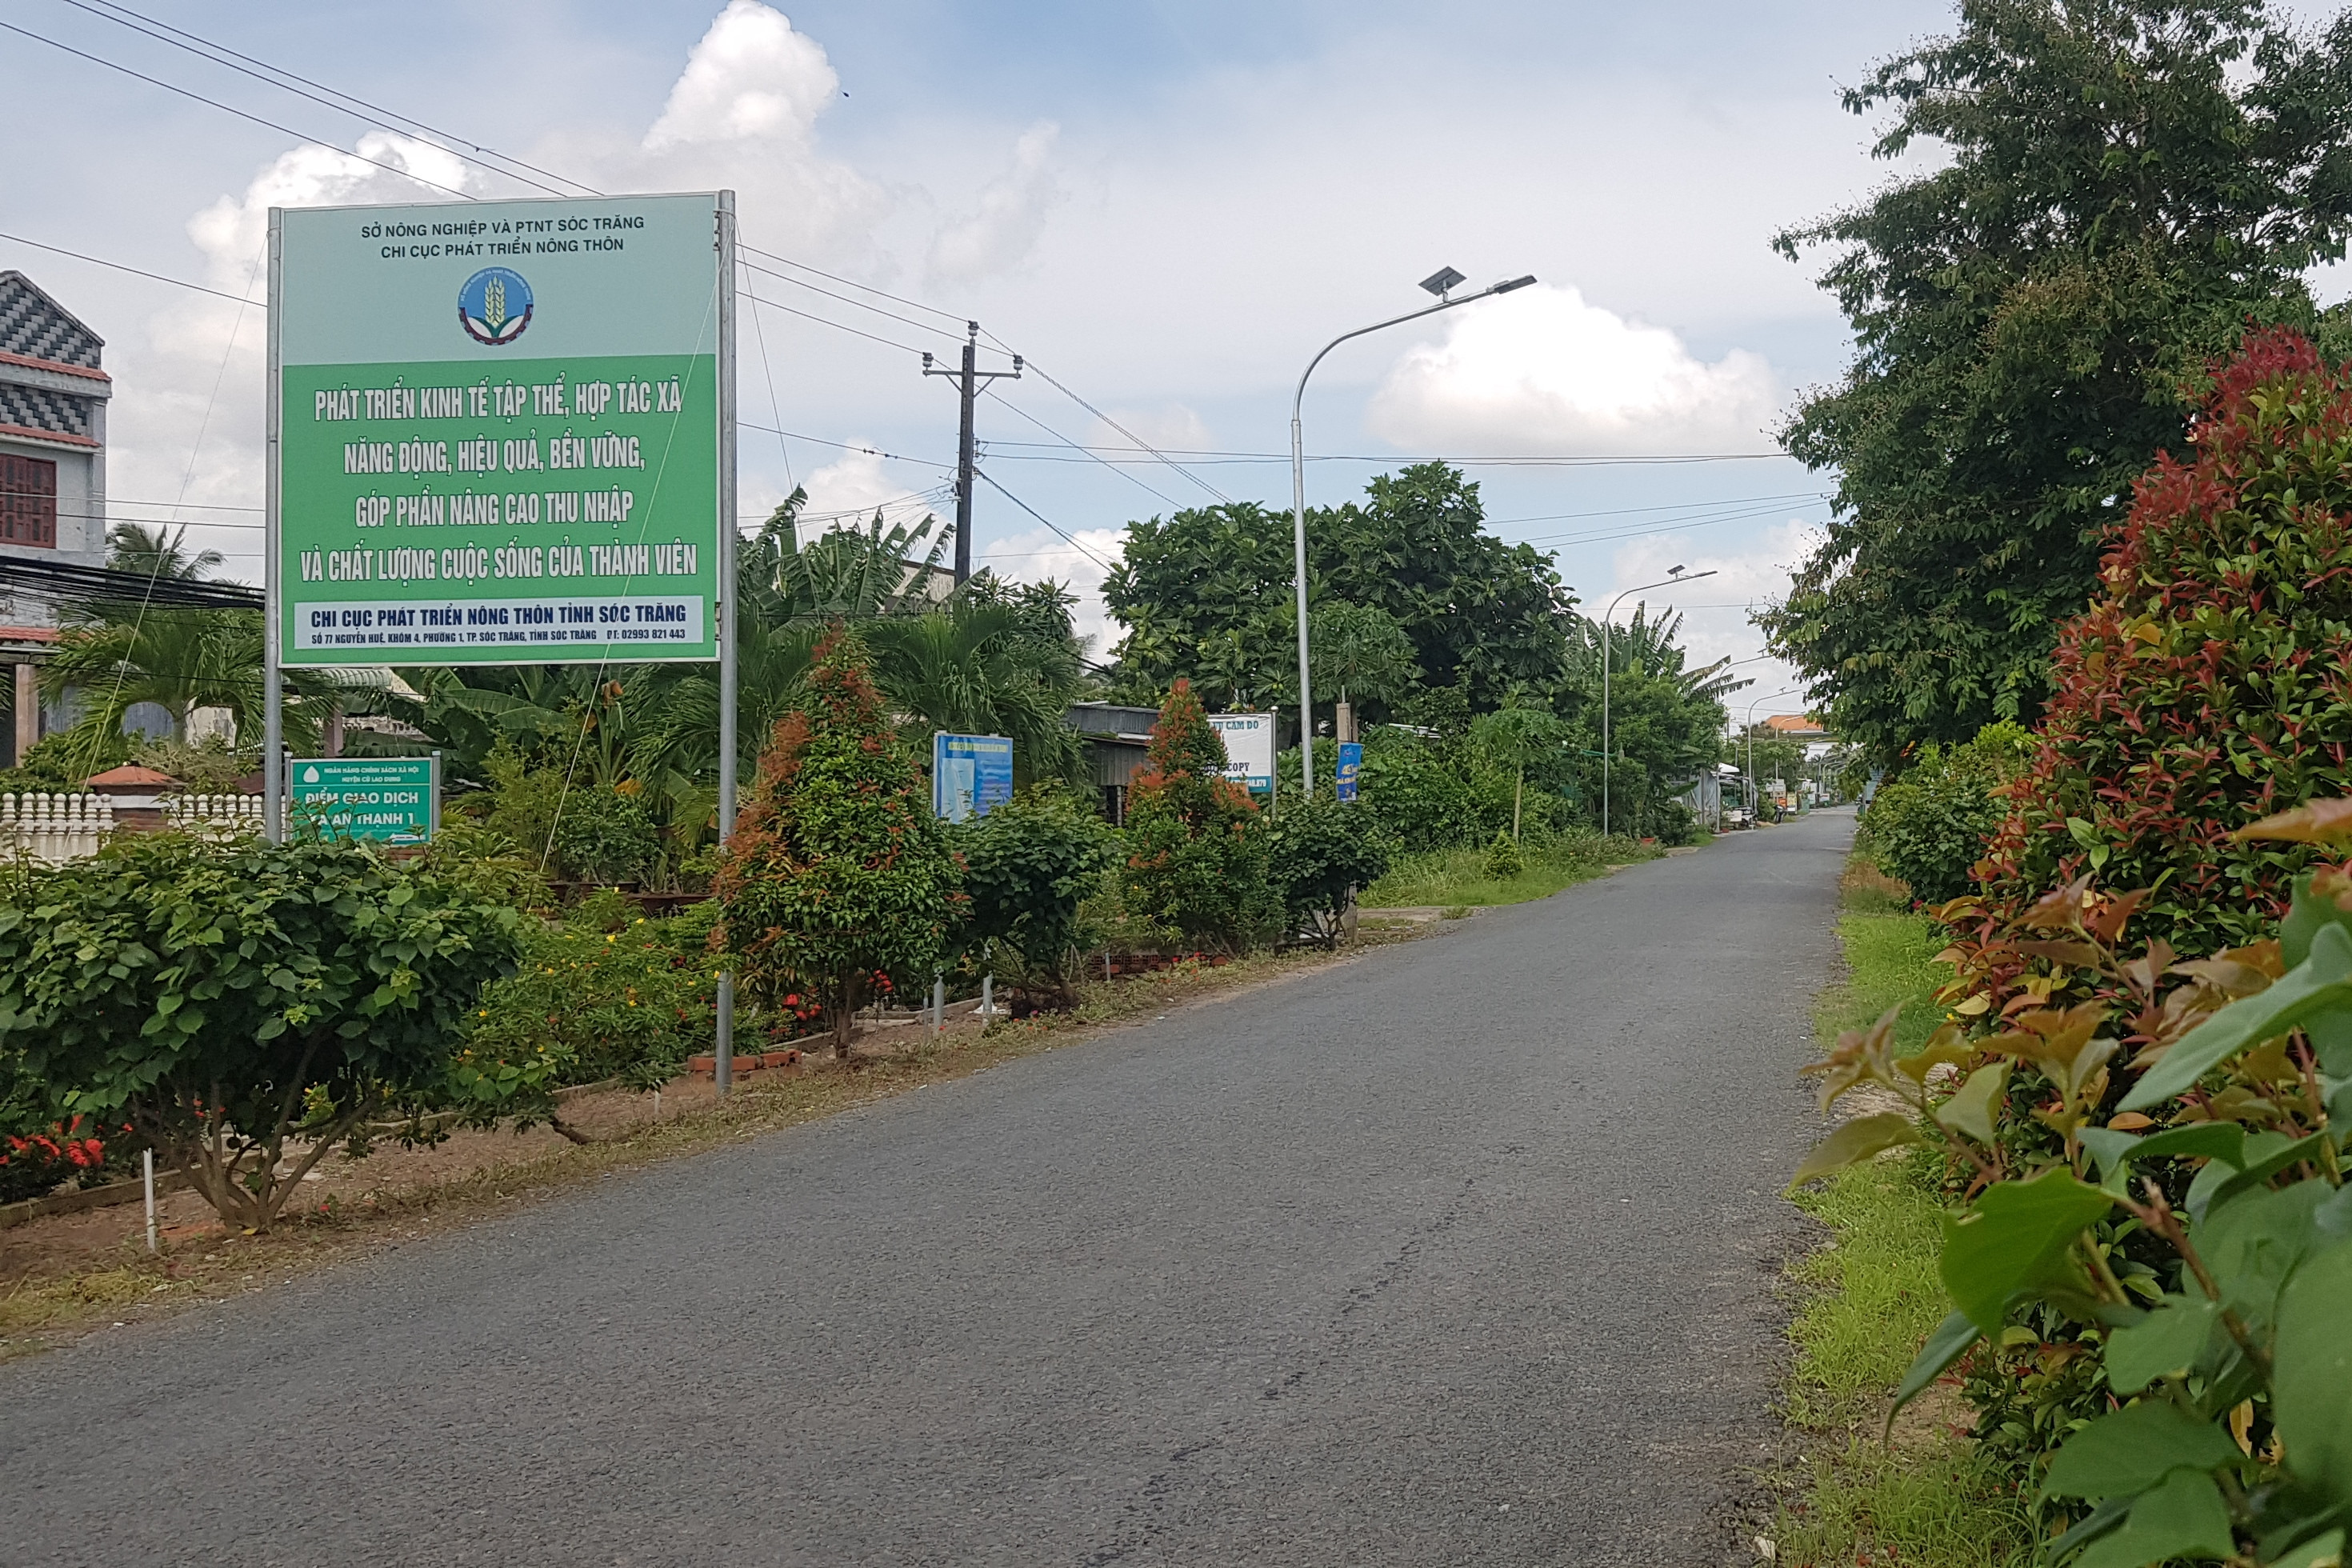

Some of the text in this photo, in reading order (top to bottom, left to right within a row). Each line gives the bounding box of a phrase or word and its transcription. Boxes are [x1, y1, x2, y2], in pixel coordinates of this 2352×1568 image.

[362, 214, 644, 238] SỞ NÔNG NGHIỆP VÀ PTNT SÓC TRĂNG
[381, 236, 624, 259] CHI CỤC PHÁT TRIỂN NÔNG THÔN
[314, 371, 682, 423] PHÁT TRIỂN KINH TẾ TẬP THỂ, HỢP TÁC XÃ
[344, 427, 646, 479] NĂNG ĐỘNG, HIỆU QUẢ, BỀN VỮNG,
[355, 483, 634, 529] GÓP PHẦN NÂNG CAO THU NHẬP
[300, 534, 698, 587] VÀ CHẤT LƯỢNG CUỘC SỐNG CỦA THÀNH VIÊN
[311, 602, 686, 630] CHI CỤC PHÁT TRIỂN NÔNG THÔN TỈNH SÓC TRĂNG
[325, 634, 333, 644] 77
[388, 632, 412, 643] KHÓM
[466, 632, 477, 642] TP.
[480, 631, 496, 642] SÓC
[551, 629, 567, 640] SÓC
[622, 630, 650, 640] 02993
[652, 629, 667, 639] 821
[669, 629, 686, 639] 443
[1227, 762, 1250, 772] COPY
[305, 786, 418, 806] ĐIỂM GIAO DỊCH
[332, 813, 352, 825] AN
[358, 813, 403, 828] THẠNH
[408, 813, 414, 825] 1
